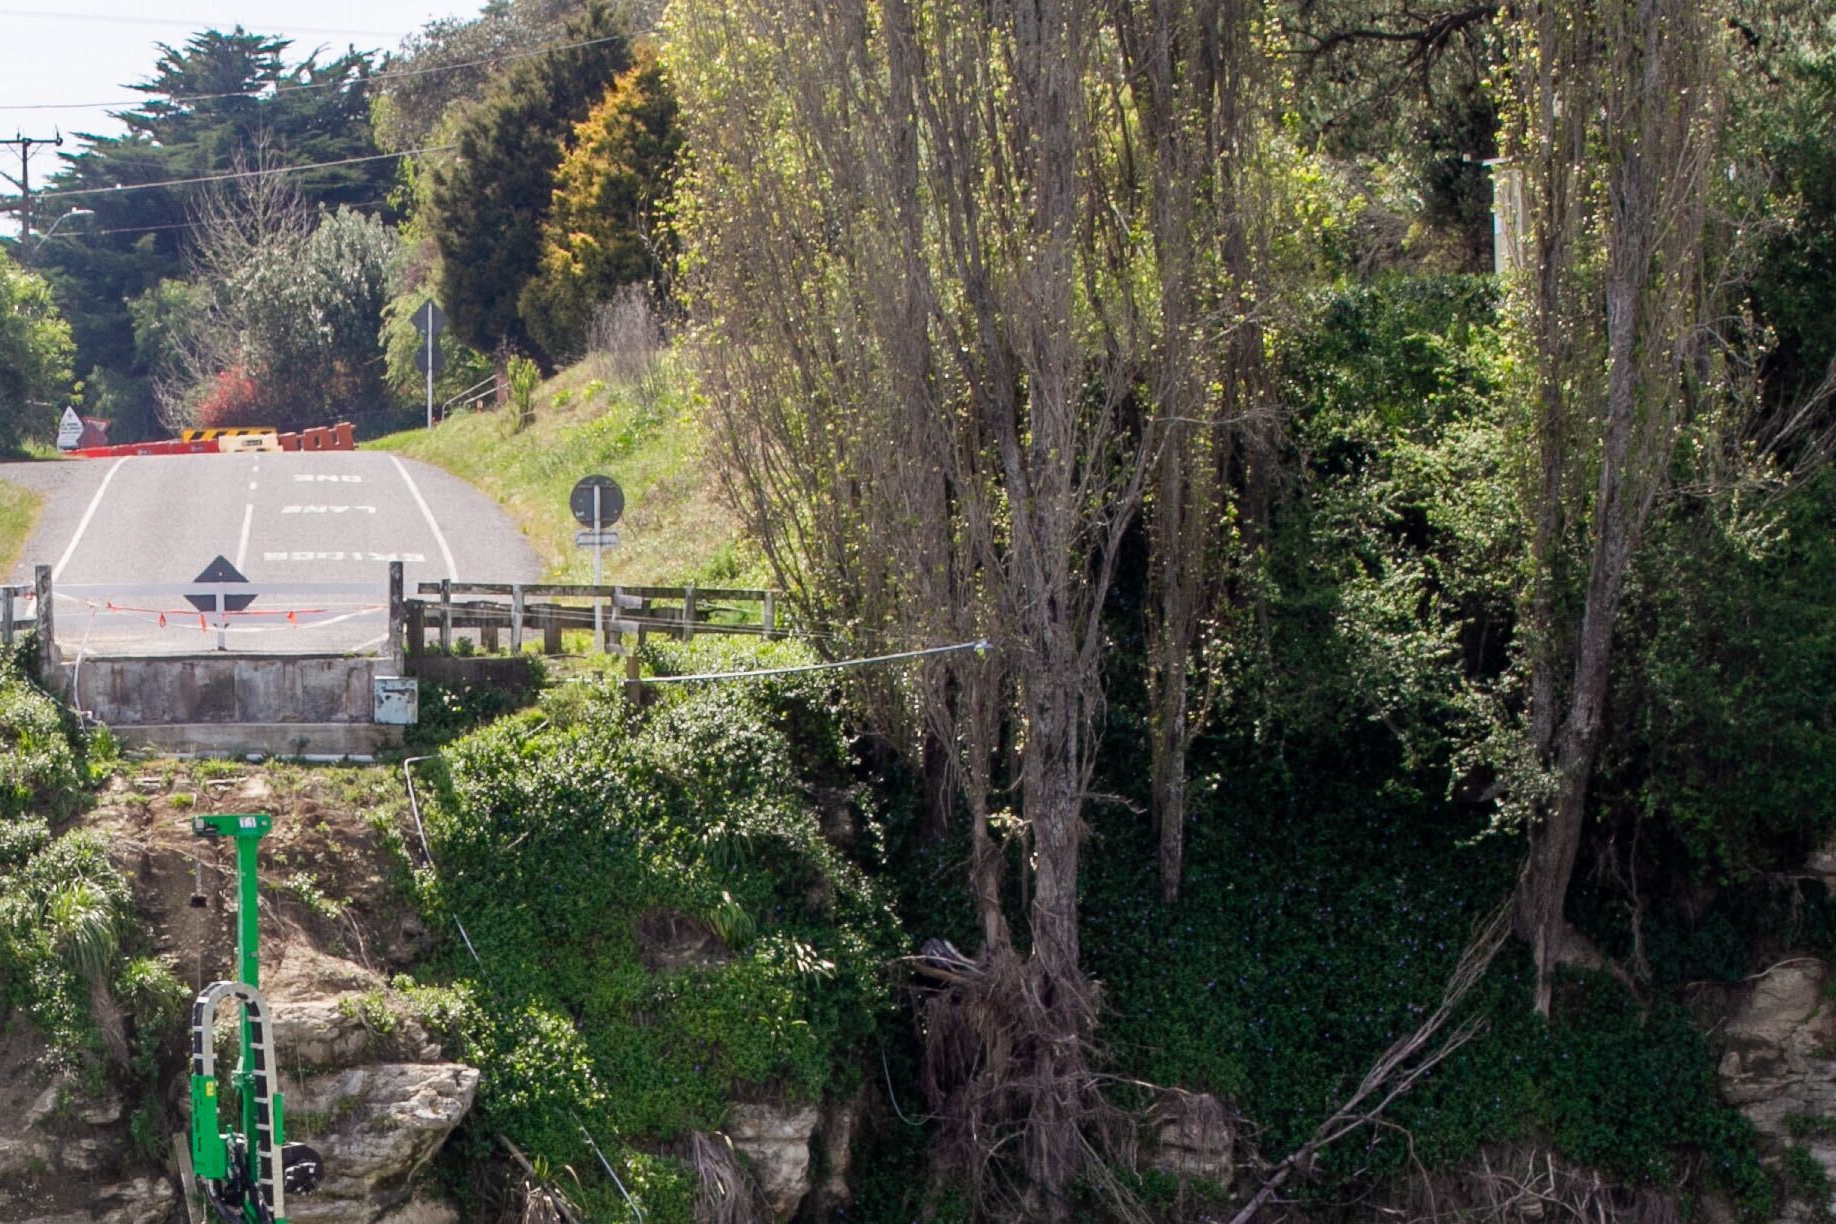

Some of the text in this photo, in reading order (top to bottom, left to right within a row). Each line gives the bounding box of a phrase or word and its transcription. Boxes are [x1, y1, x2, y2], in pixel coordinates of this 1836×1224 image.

[293, 474, 362, 483] ONE
[281, 505, 377, 514] LANE
[264, 552, 426, 562] BRIDGE
